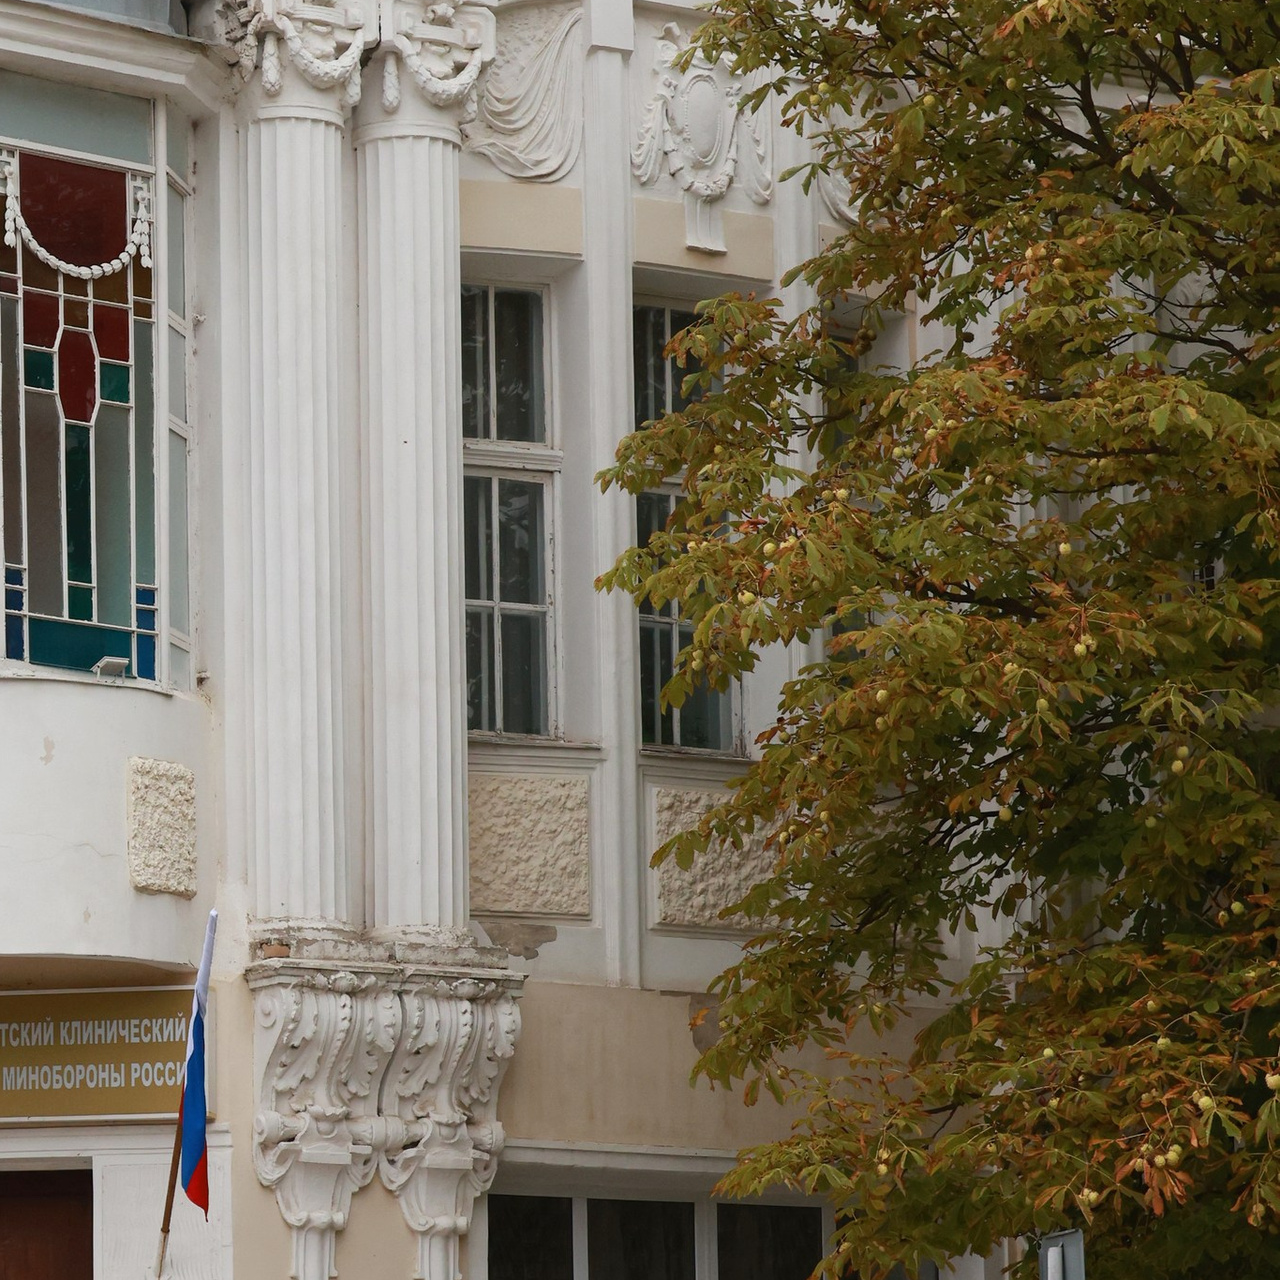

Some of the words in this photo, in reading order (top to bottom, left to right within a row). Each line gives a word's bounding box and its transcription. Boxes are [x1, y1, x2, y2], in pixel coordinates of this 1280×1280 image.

[60, 1011, 186, 1046] КЛИНИЧЕСКИЙ
[2, 1063, 125, 1091] МИНОБОРОНЫ
[130, 1062, 187, 1087] РОССИ
